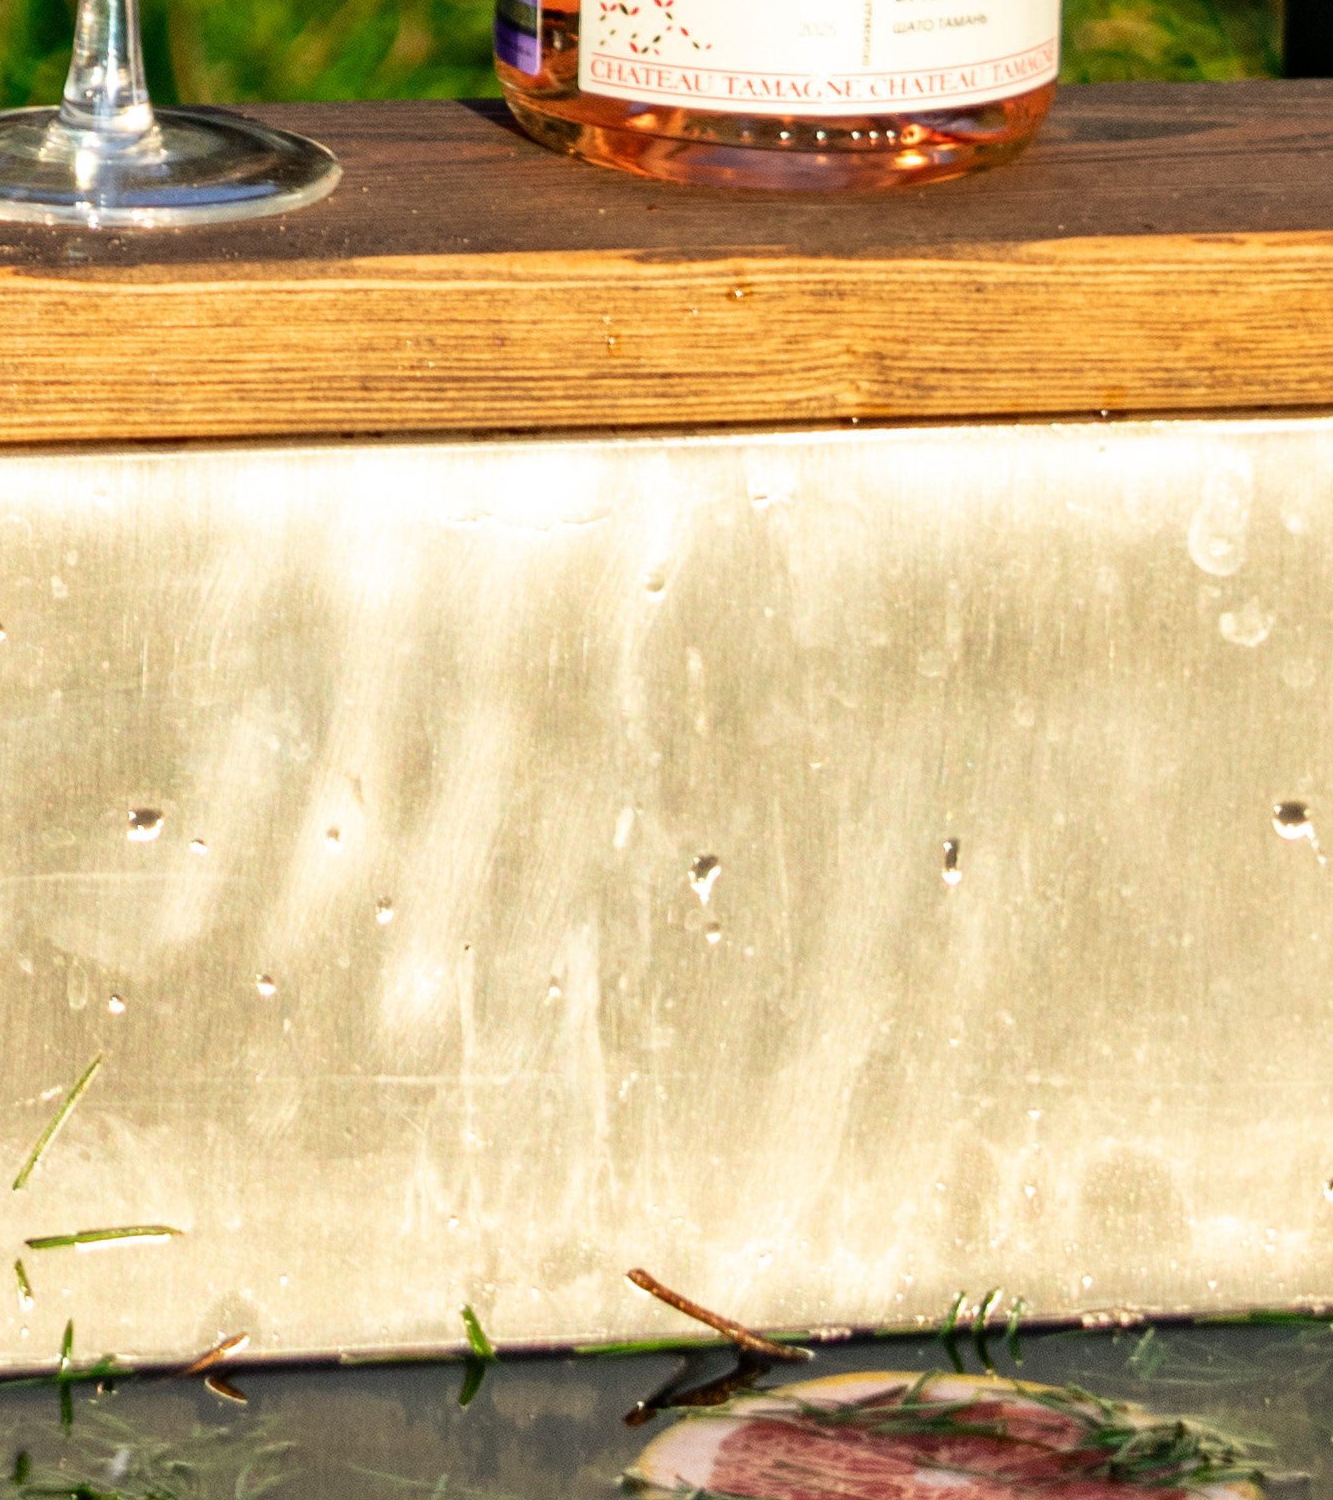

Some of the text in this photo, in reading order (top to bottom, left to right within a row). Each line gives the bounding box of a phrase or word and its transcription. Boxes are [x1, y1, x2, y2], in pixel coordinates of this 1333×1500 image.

[893, 12, 988, 34] ШАТО ТАМАНЬ
[590, 59, 712, 92] CHATEAU
[723, 75, 860, 98] TAMAGNE
[870, 68, 984, 96] CHATEAU
